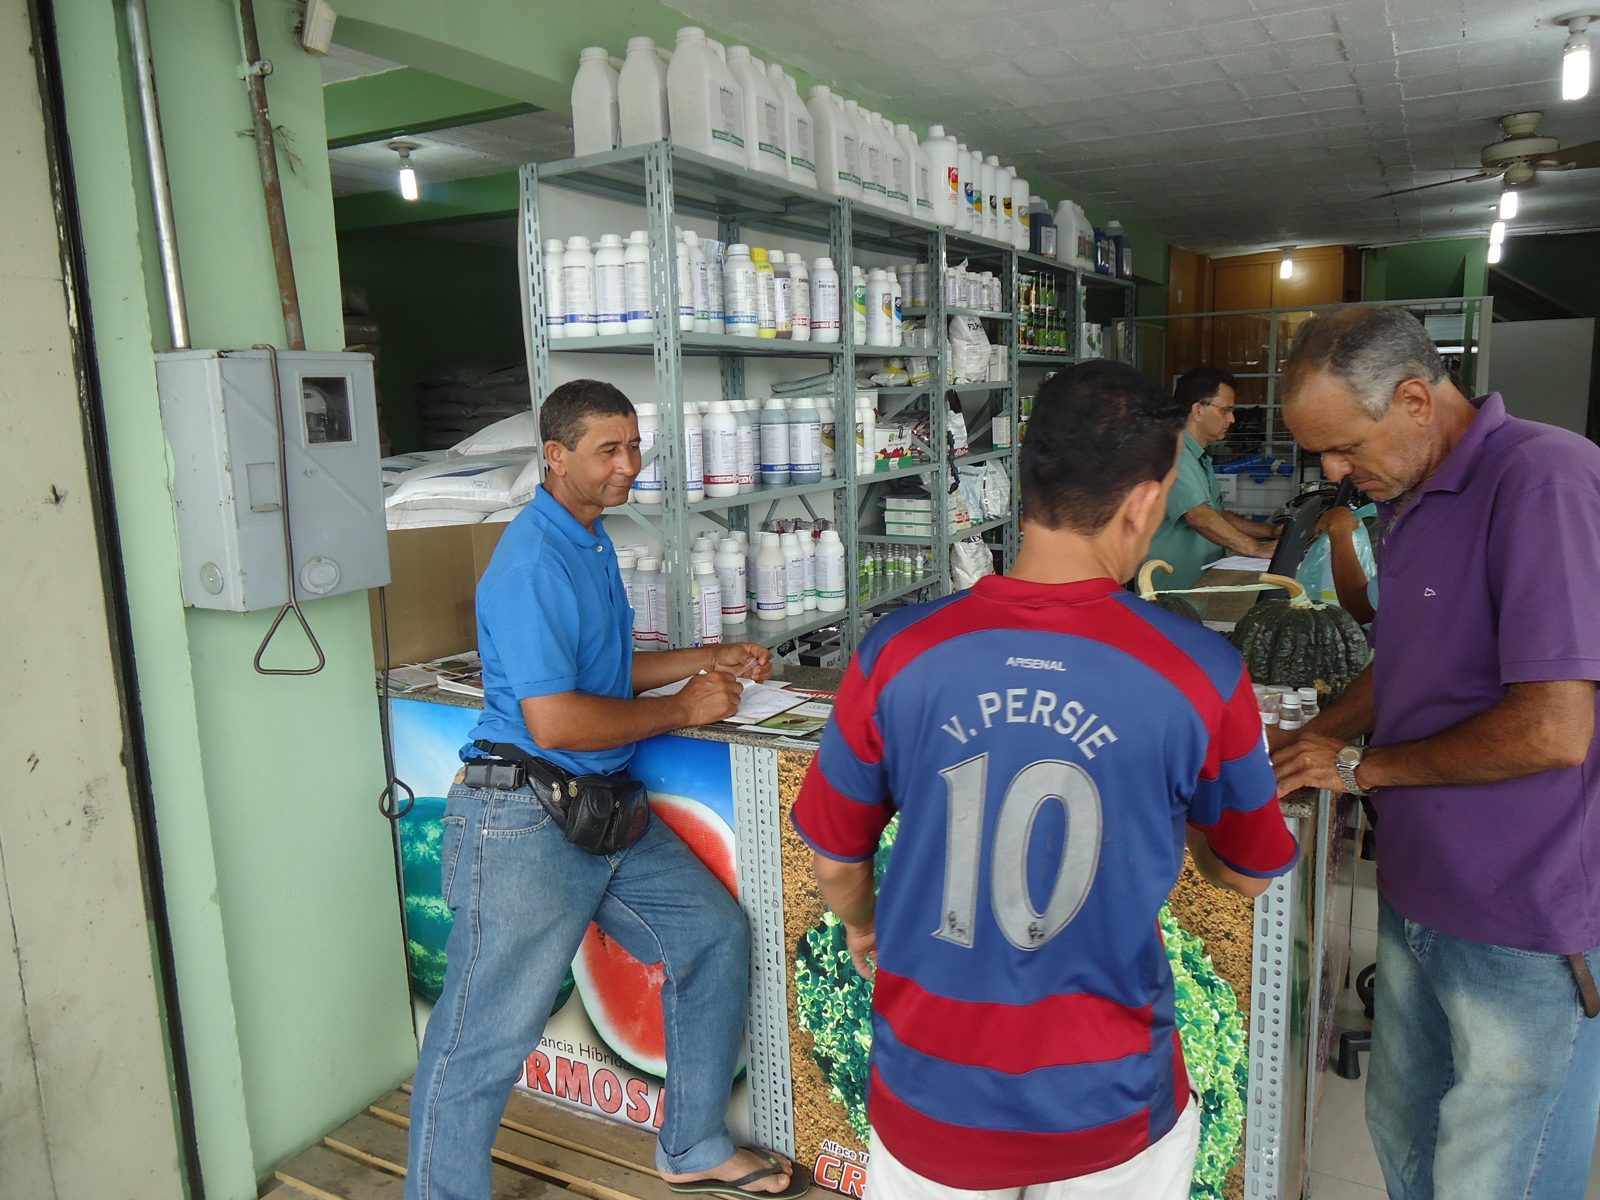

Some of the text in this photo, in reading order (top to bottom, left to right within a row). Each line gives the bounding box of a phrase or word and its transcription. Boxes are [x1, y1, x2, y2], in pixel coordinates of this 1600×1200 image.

[1004, 656, 1067, 671] ARSENAL
[941, 688, 1119, 760] V. PERSIE
[931, 751, 1103, 952] 10
[541, 1036, 574, 1055] ancia
[515, 1049, 666, 1128] RMOS
[822, 1139, 857, 1160] Alface
[813, 1154, 868, 1199] CR
